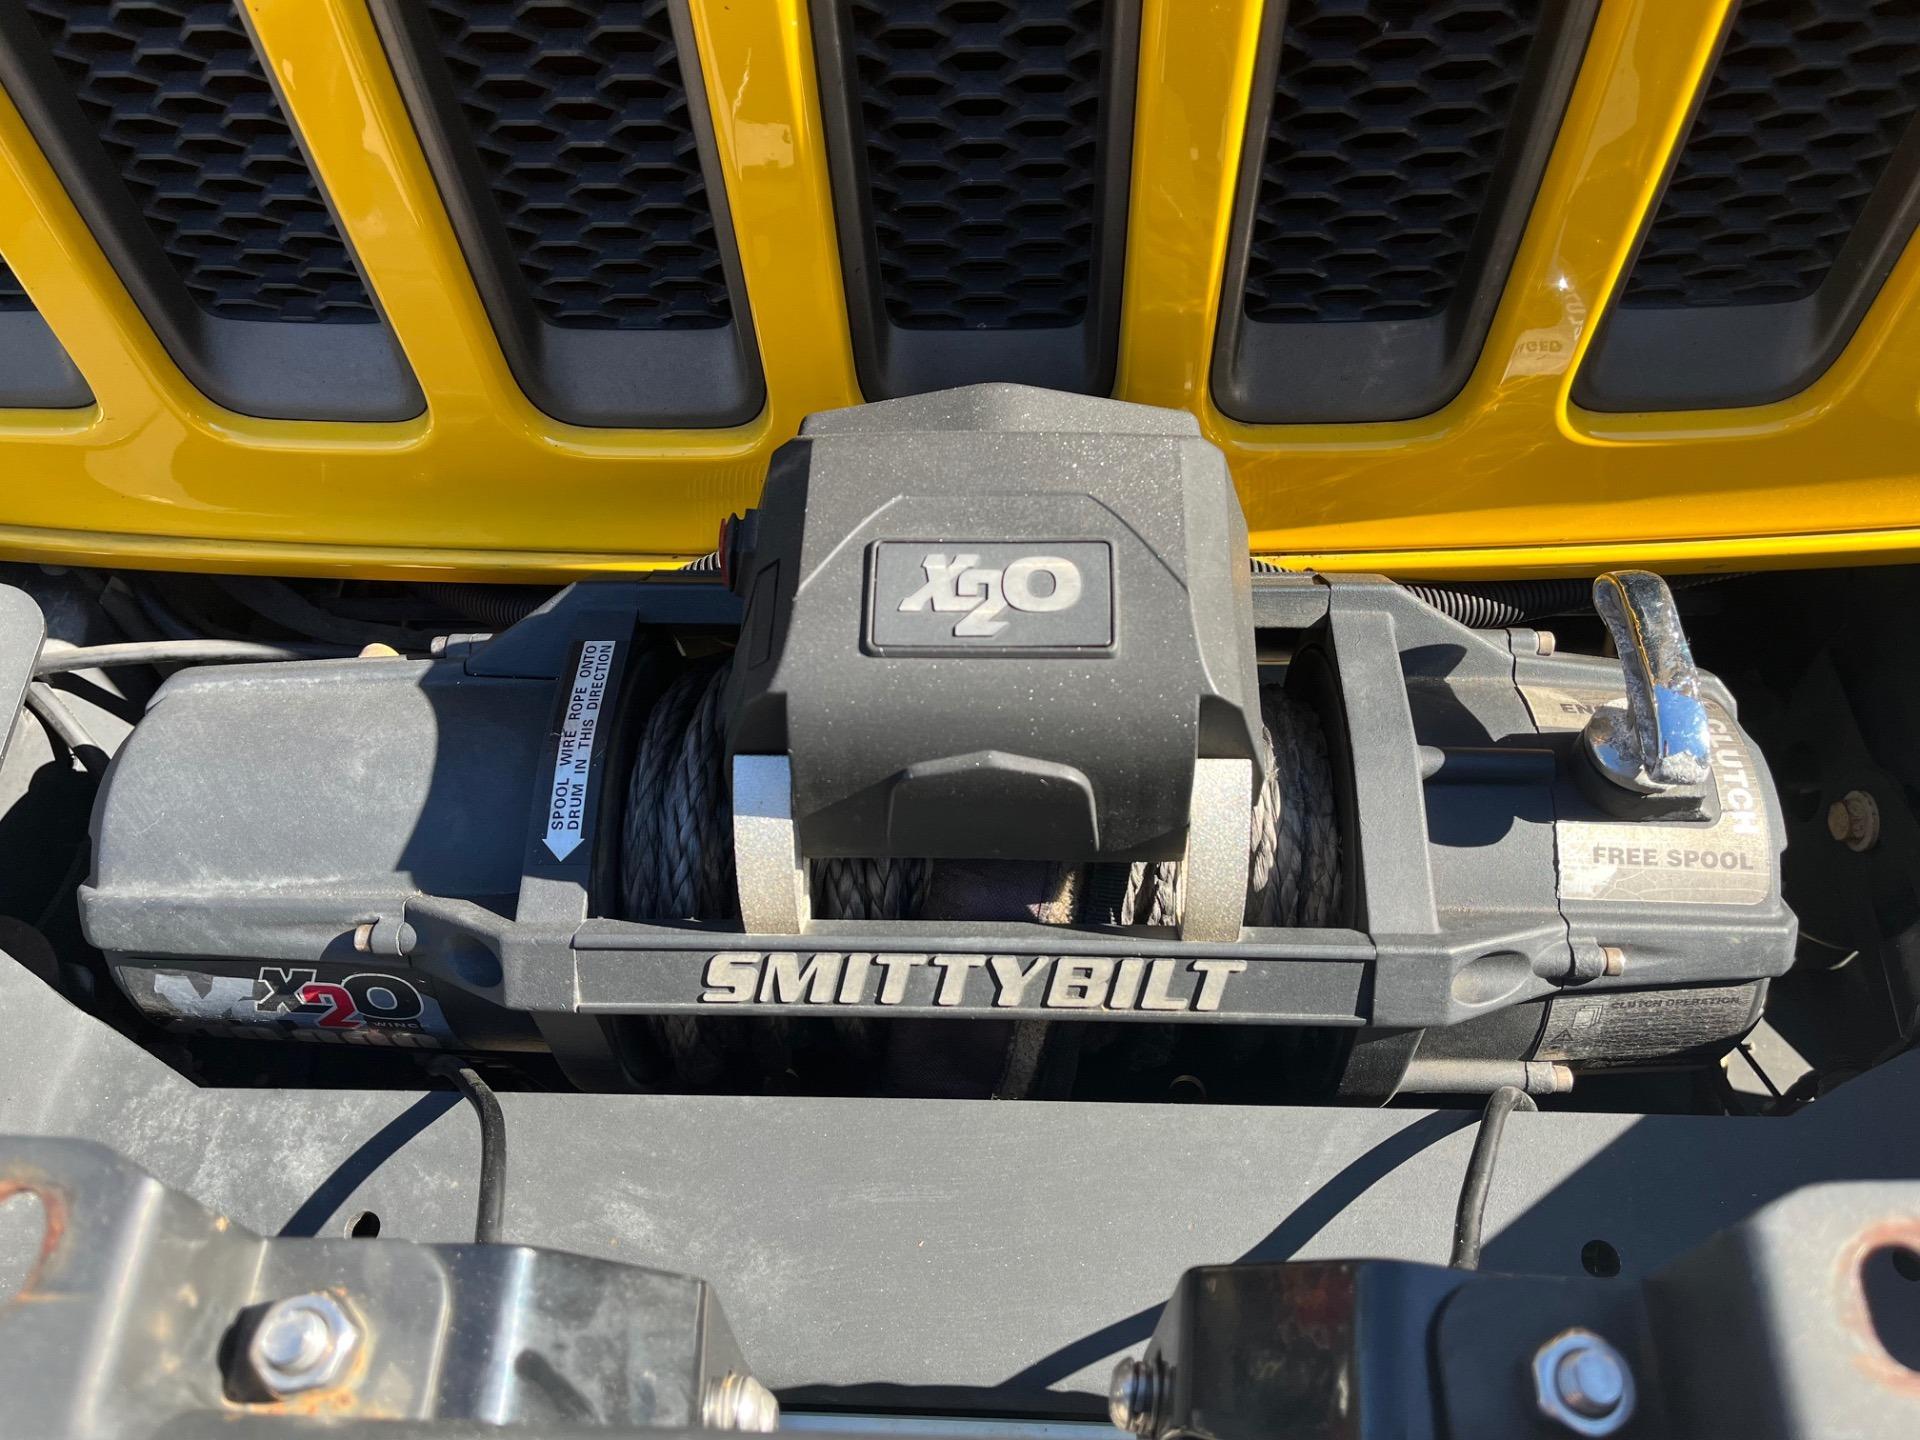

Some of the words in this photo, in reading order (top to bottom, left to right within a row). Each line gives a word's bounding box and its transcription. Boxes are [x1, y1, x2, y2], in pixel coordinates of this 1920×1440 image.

[580, 645, 597, 678] ONTO
[587, 645, 612, 710] DIRECTION
[570, 687, 587, 720] ROPE
[560, 730, 577, 766] WIRE
[577, 719, 594, 750] THIS
[574, 759, 587, 774] IN
[1708, 719, 1760, 834] CLUTCH
[551, 777, 570, 830] SPOOL
[567, 784, 584, 830] DRUM
[1592, 845, 1658, 866] FREE
[1666, 849, 1754, 870] SPOOL
[698, 951, 1247, 1012] SMITTYBILT
[1611, 999, 1663, 1009] CLUTCH
[1665, 996, 1740, 1007] OPERATION
